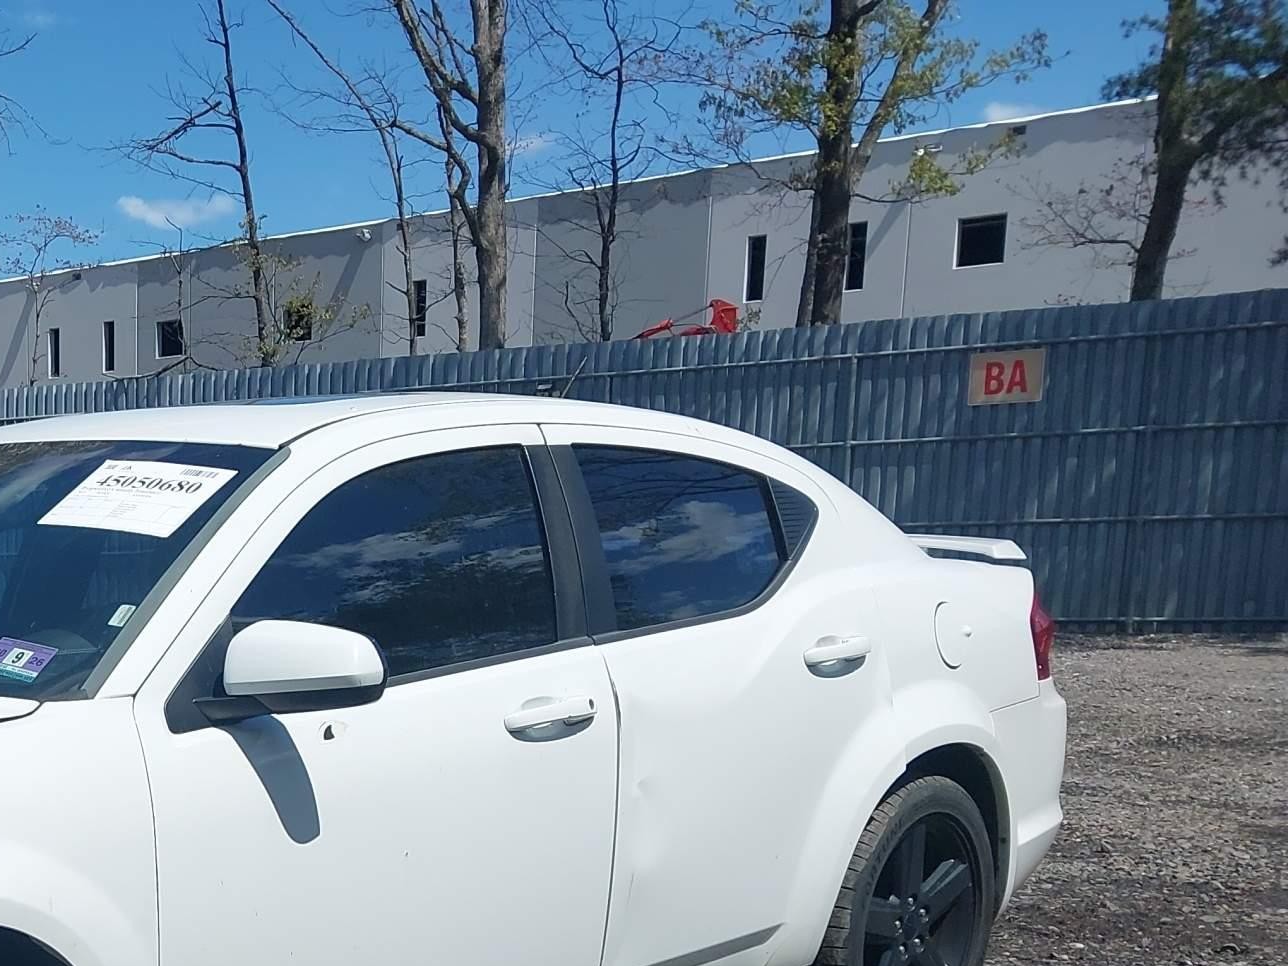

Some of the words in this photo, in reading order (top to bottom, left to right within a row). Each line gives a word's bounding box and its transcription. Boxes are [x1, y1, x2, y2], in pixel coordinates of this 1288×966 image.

[983, 358, 1028, 396] BA
[95, 474, 203, 495] 45050680
[11, 651, 25, 664] 9
[28, 656, 46, 667] 26
